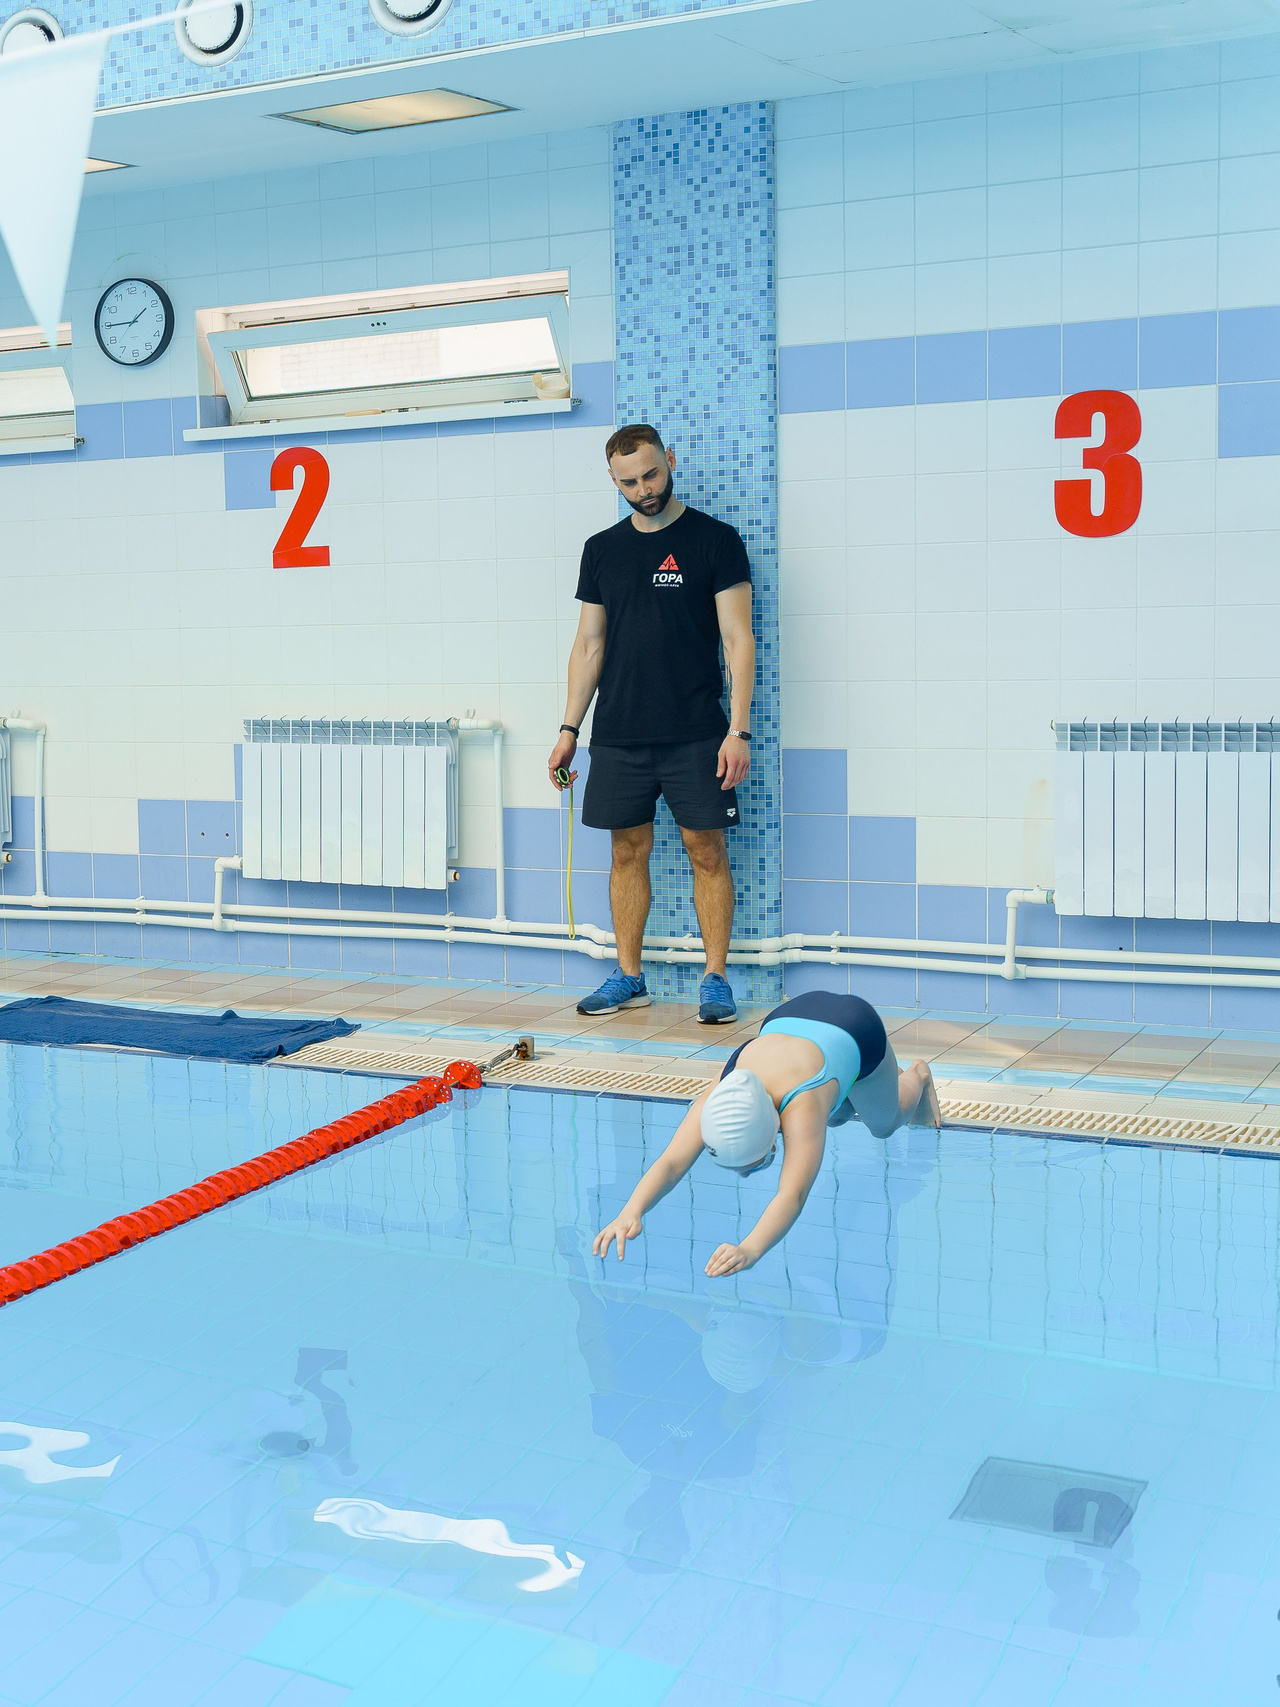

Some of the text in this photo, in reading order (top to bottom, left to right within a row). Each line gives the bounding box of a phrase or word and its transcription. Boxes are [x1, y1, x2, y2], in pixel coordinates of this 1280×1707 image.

[126, 286, 137, 295] 12
[142, 290, 147, 298] 1
[150, 300, 158, 308] 2
[106, 305, 118, 314] 10
[155, 314, 163, 322] 3
[110, 336, 117, 344] 8
[119, 346, 127, 354] 7
[145, 342, 153, 351] 5
[132, 349, 139, 357] 6
[1054, 389, 1143, 538] 3
[270, 446, 330, 569] 2
[652, 573, 683, 584] ГОРА
